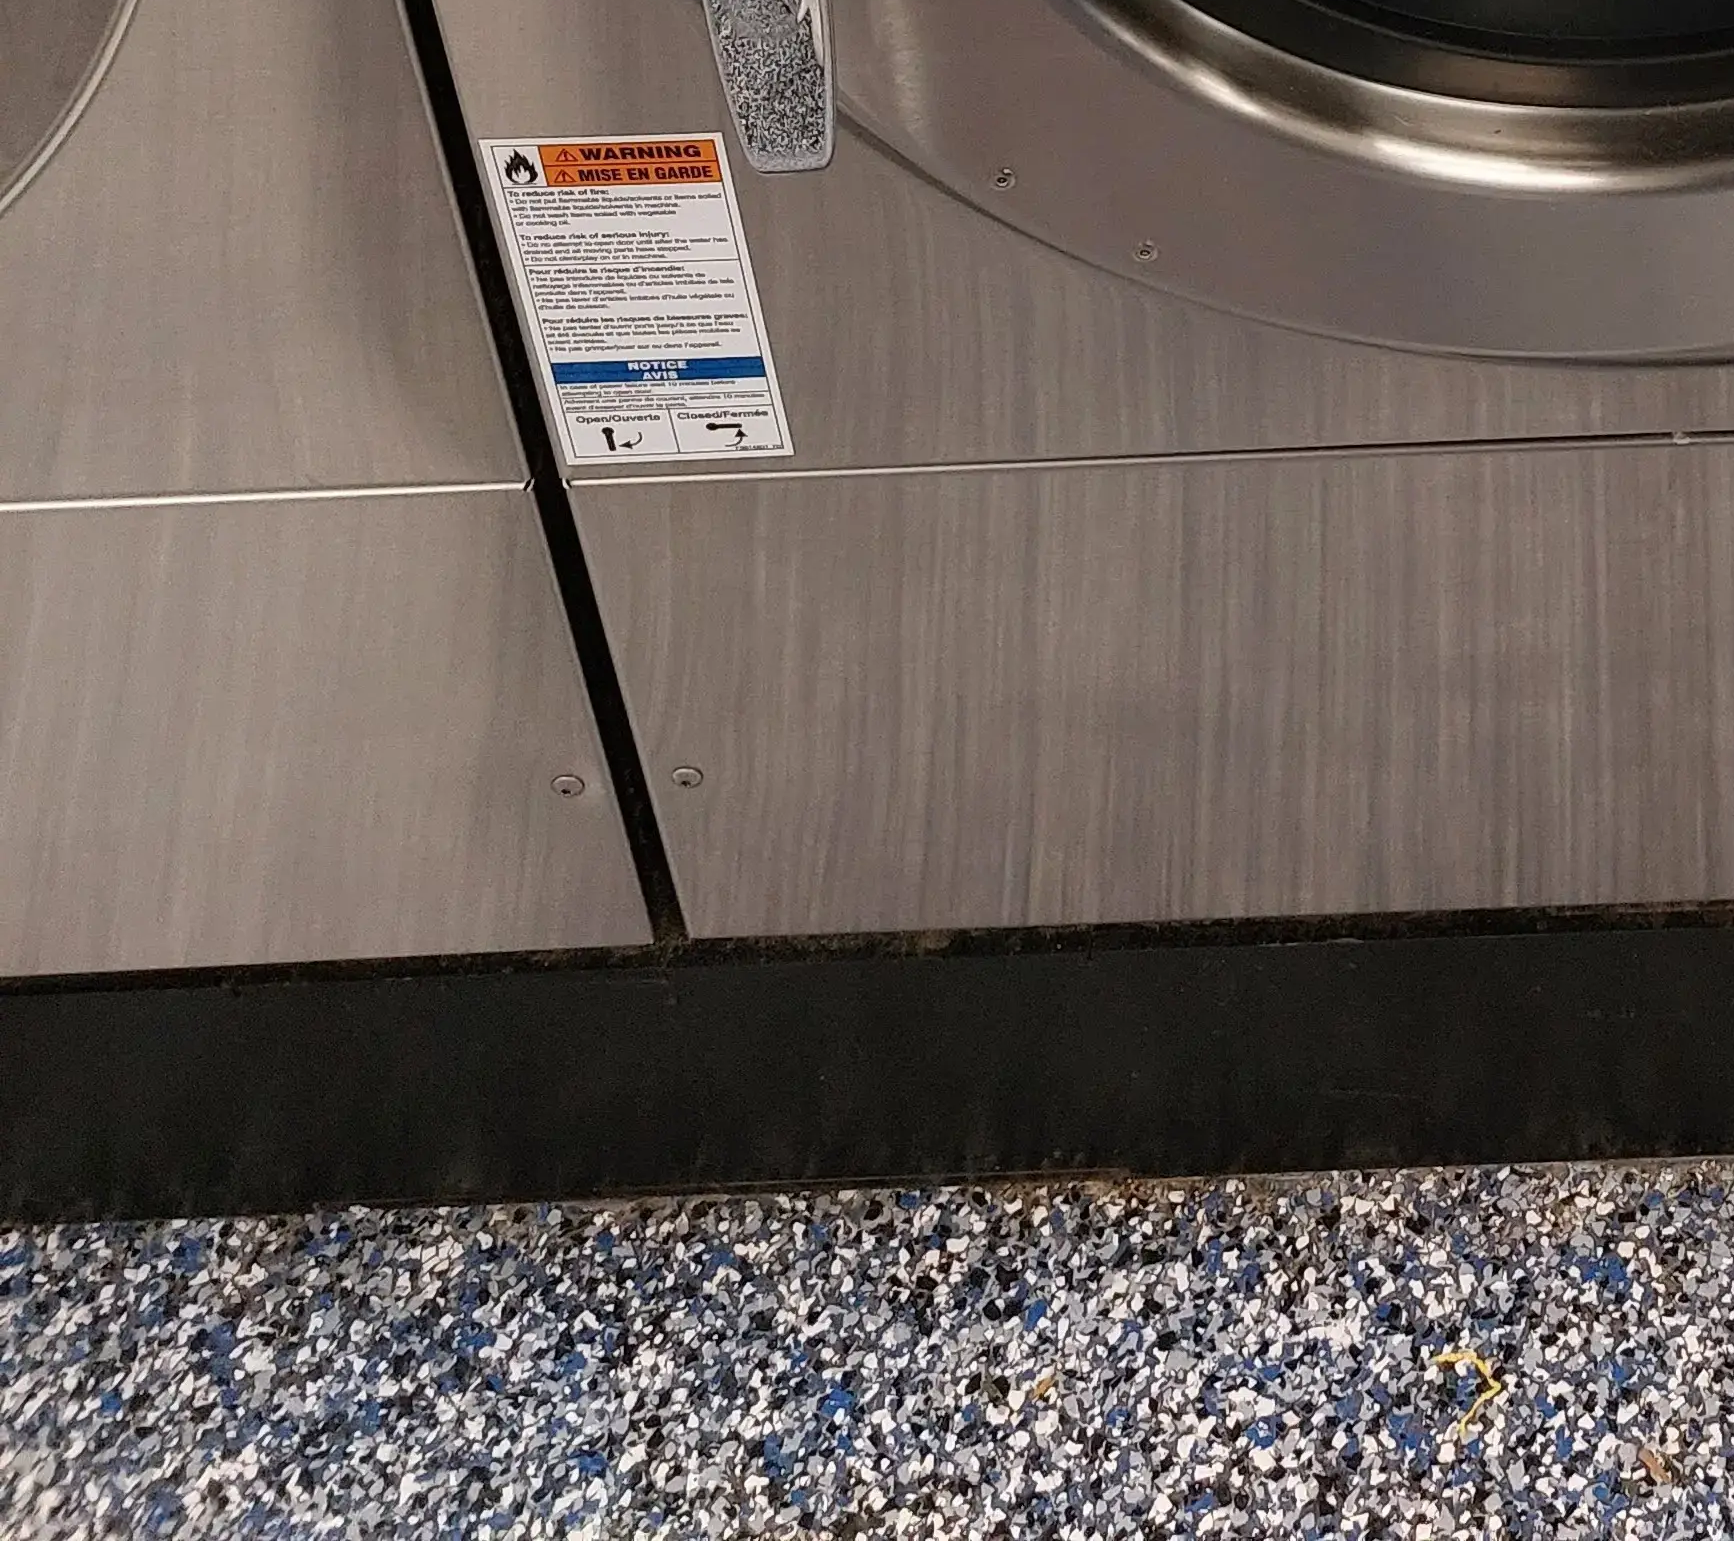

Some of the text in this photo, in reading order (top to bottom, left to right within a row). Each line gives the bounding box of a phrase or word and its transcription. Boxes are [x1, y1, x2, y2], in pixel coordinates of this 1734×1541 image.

[578, 145, 701, 161] WARNING
[577, 165, 713, 182] MISE EN GARDE
[627, 361, 688, 371] NOTICE
[643, 371, 678, 380] AVIS
